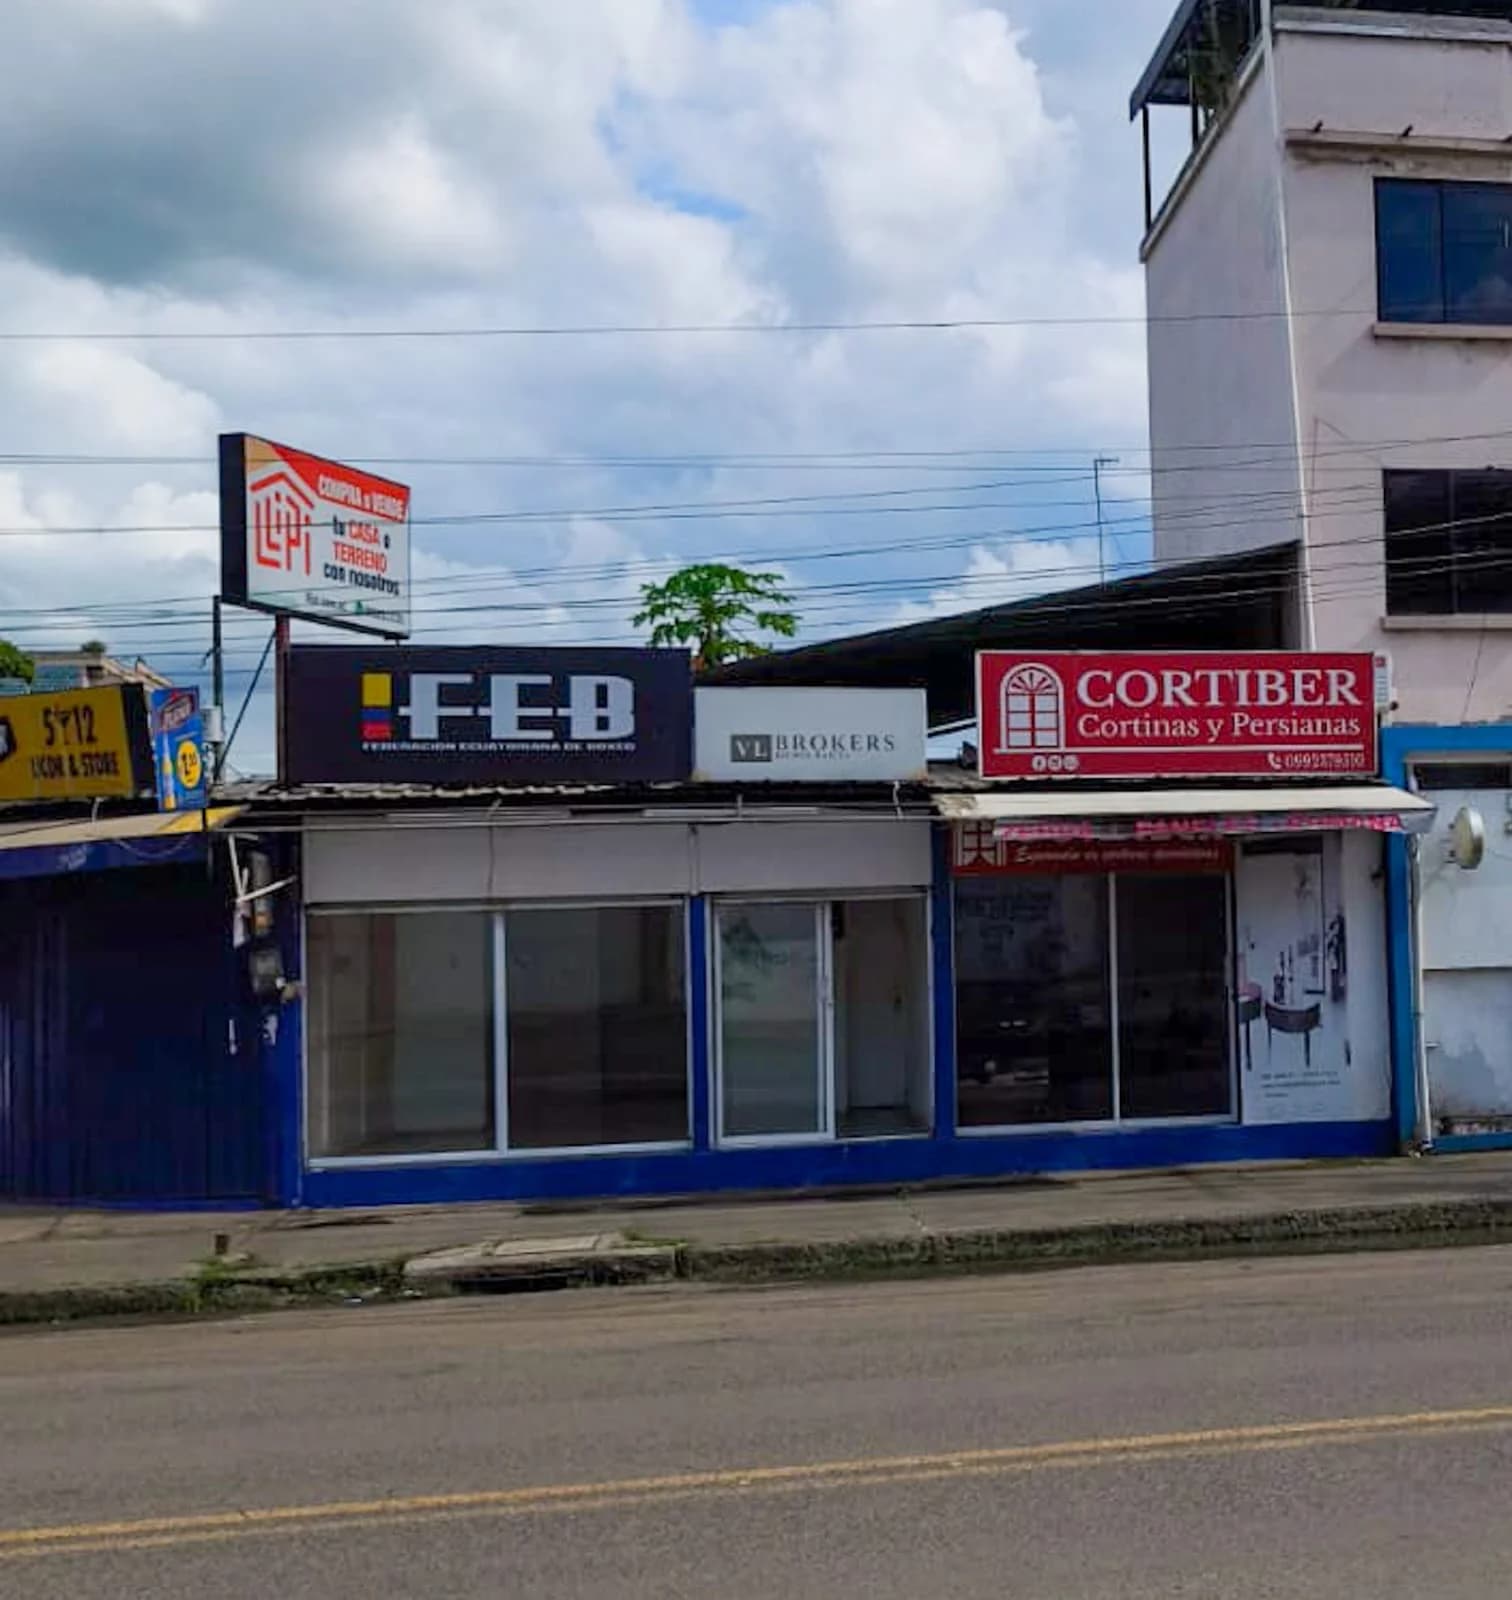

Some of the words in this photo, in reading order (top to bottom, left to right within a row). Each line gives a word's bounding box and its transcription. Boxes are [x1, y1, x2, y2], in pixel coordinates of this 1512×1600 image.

[349, 520, 379, 544] CASA
[333, 541, 387, 573] TERRENO
[324, 563, 345, 582] con
[349, 569, 399, 596] nosotros
[1076, 669, 1361, 708] CORTIBER
[399, 674, 634, 740] FEB
[1077, 713, 1199, 738] Cortinas
[1205, 719, 1224, 742] y
[1231, 711, 1360, 736] Persianas
[733, 738, 769, 758] VL
[776, 734, 895, 750] BROKERS
